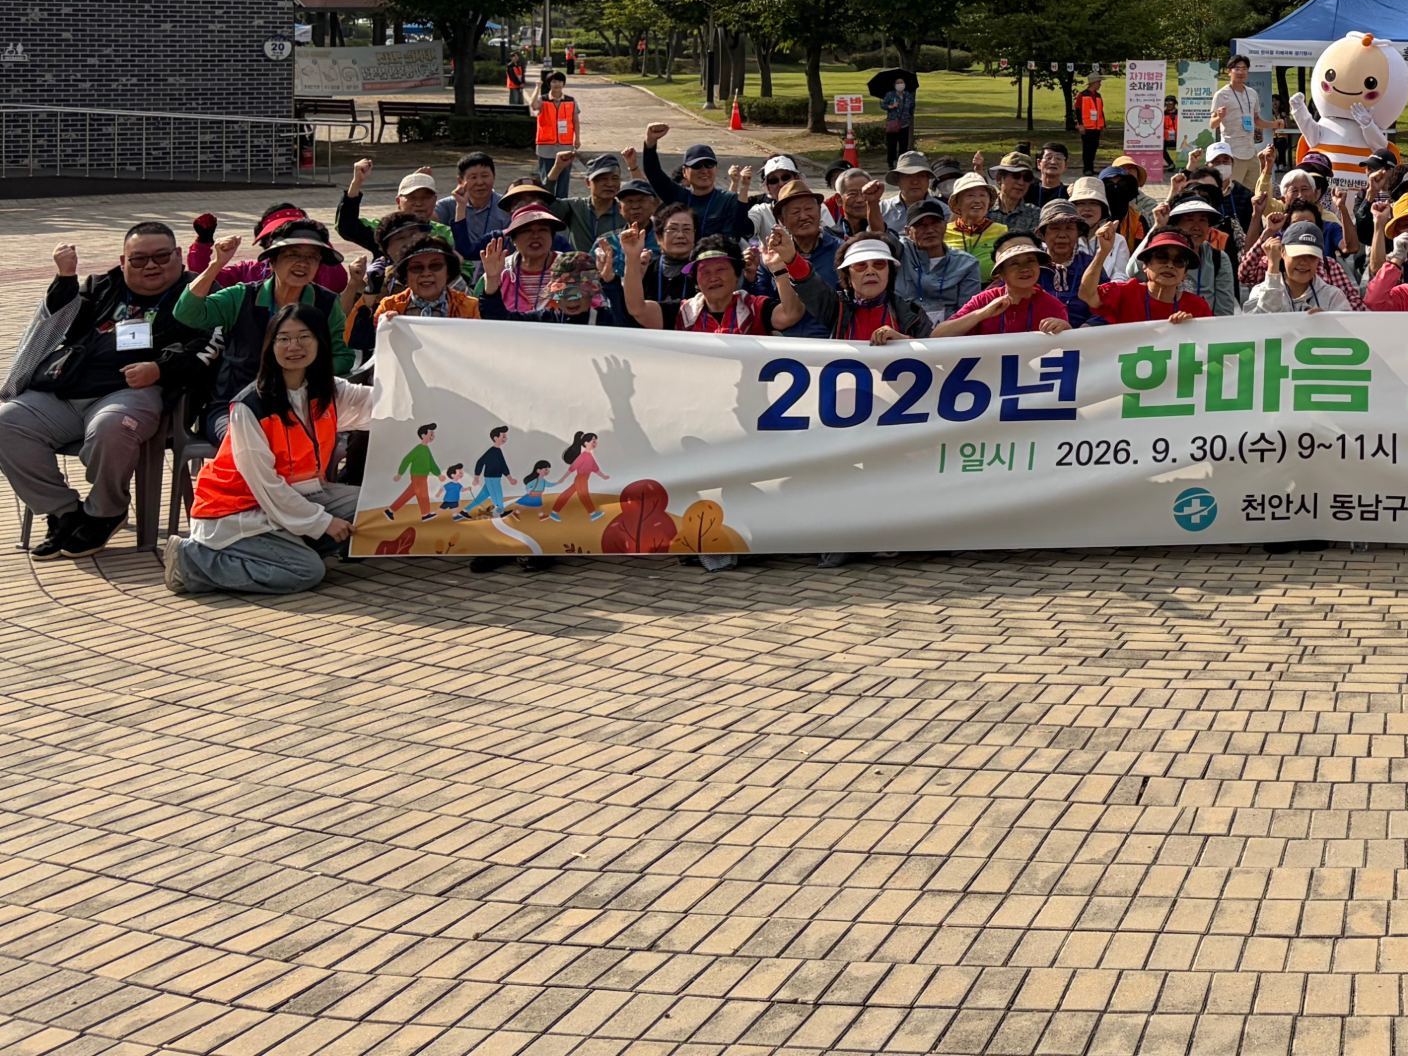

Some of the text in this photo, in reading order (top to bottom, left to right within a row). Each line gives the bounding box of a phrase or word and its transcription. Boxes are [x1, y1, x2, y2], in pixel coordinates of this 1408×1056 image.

[758, 350, 1080, 431] 2026년
[1118, 337, 1372, 419] 한마음
[1056, 439, 1139, 467] 2026.
[1152, 437, 1178, 464] 9.
[1189, 430, 1287, 465] 30.(수)
[1297, 432, 1399, 464] 9~11시
[1241, 493, 1319, 522] 천안시
